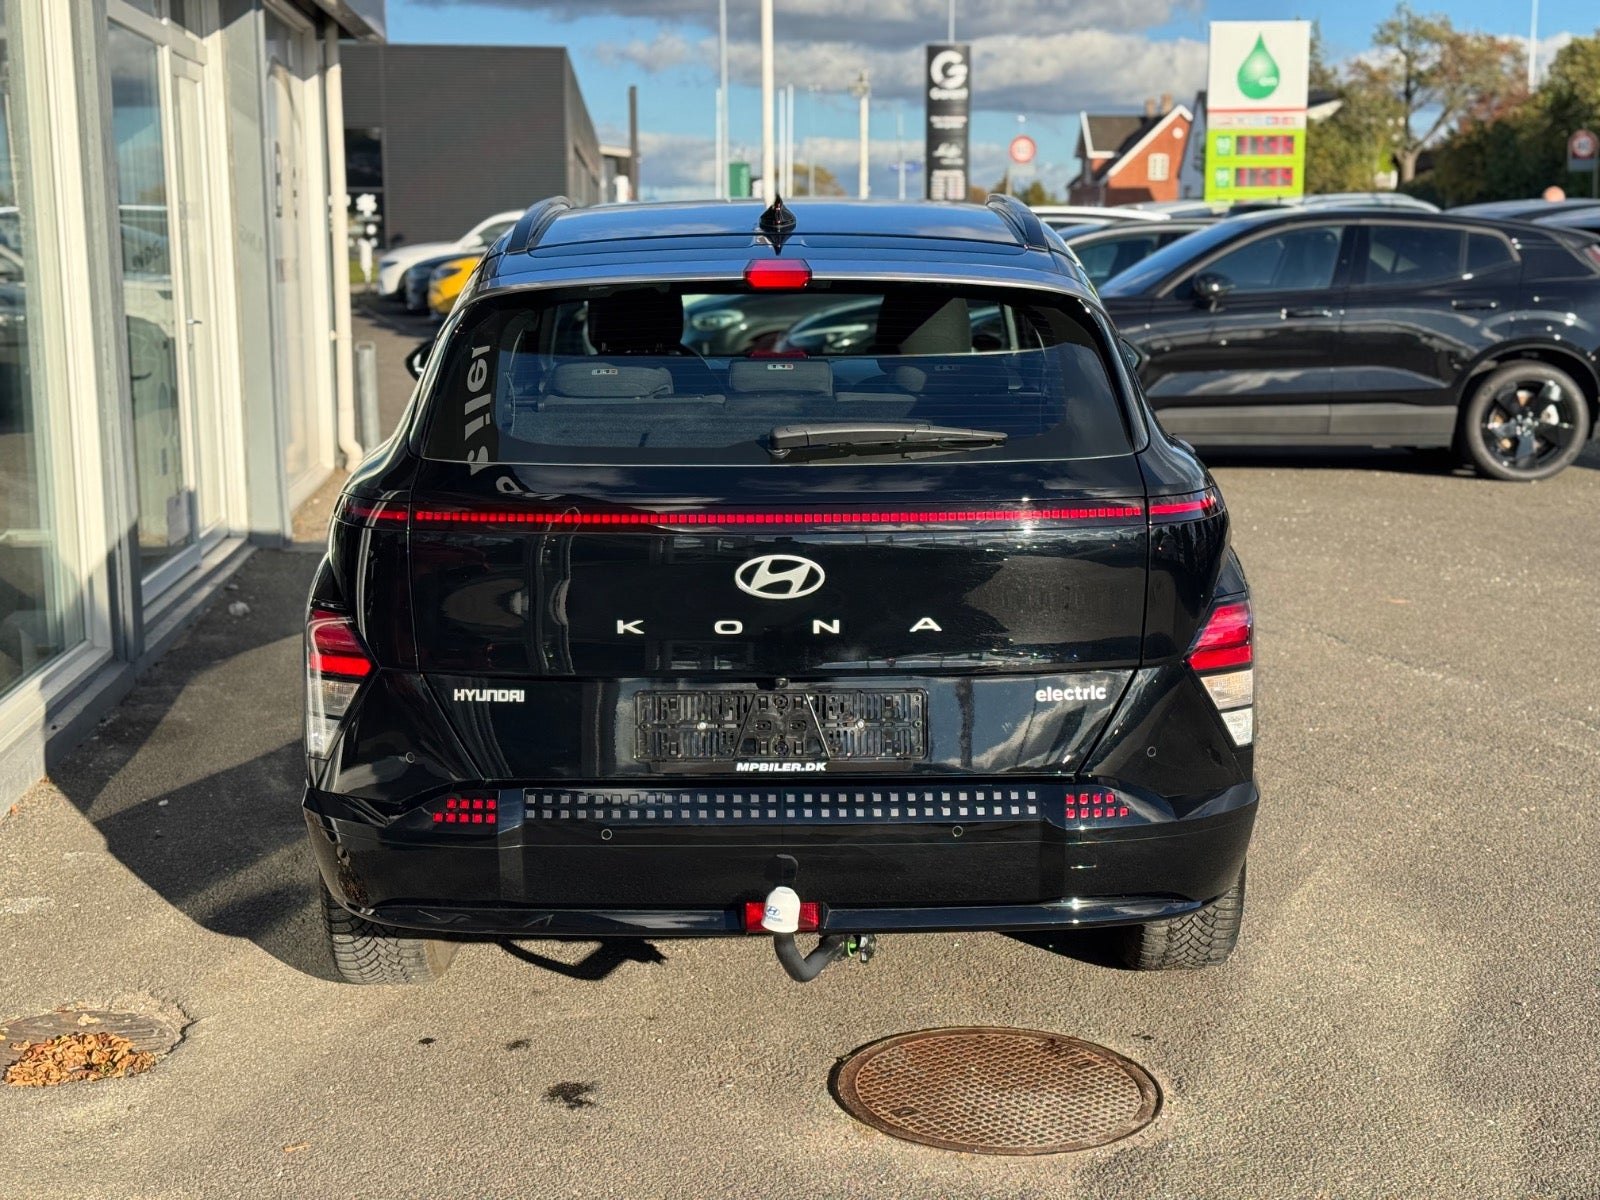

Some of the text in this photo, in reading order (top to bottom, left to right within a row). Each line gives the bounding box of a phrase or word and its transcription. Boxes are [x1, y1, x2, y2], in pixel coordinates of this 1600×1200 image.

[616, 617, 943, 636] KONA
[453, 688, 525, 703] HYUNDAI
[1035, 684, 1107, 702] electric
[735, 762, 827, 772] MPBILER.DK
